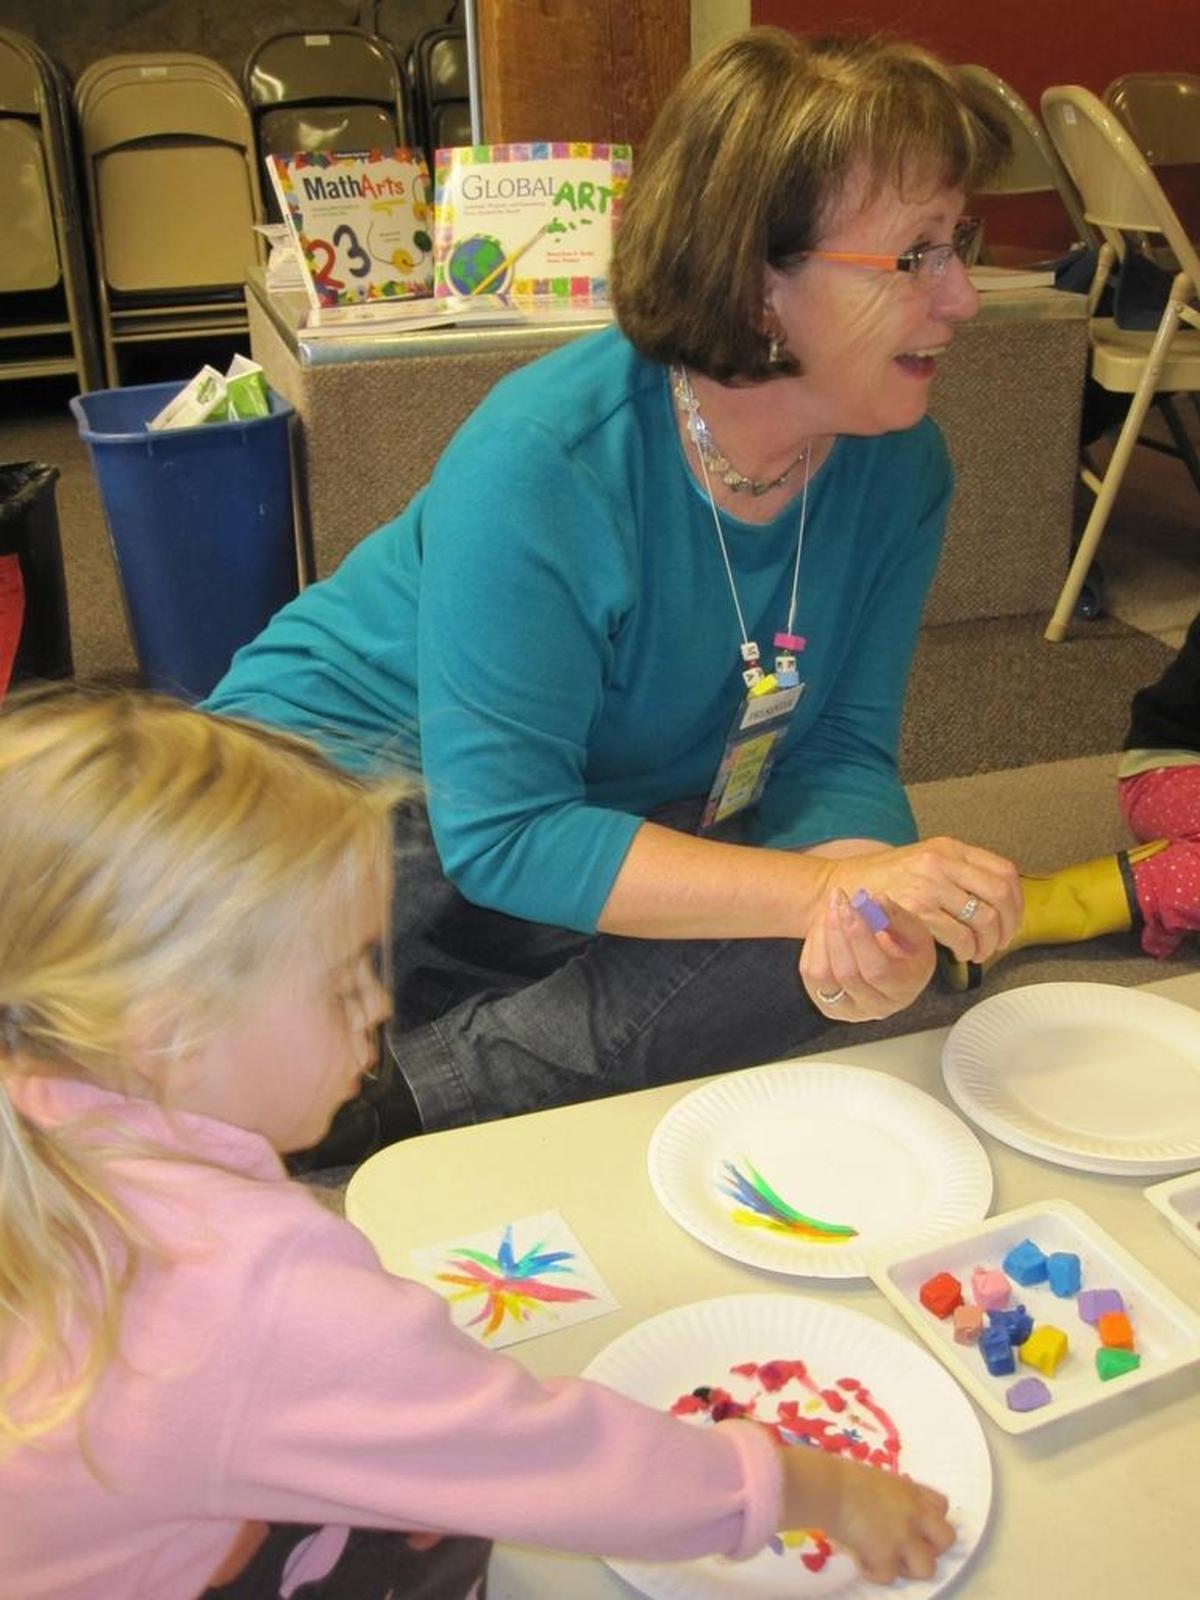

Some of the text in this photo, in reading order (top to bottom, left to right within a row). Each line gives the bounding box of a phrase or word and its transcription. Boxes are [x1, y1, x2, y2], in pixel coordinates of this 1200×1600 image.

[303, 174, 405, 201] MathArts
[462, 174, 614, 214] GLOBAL ART
[308, 224, 372, 289] 2 3
